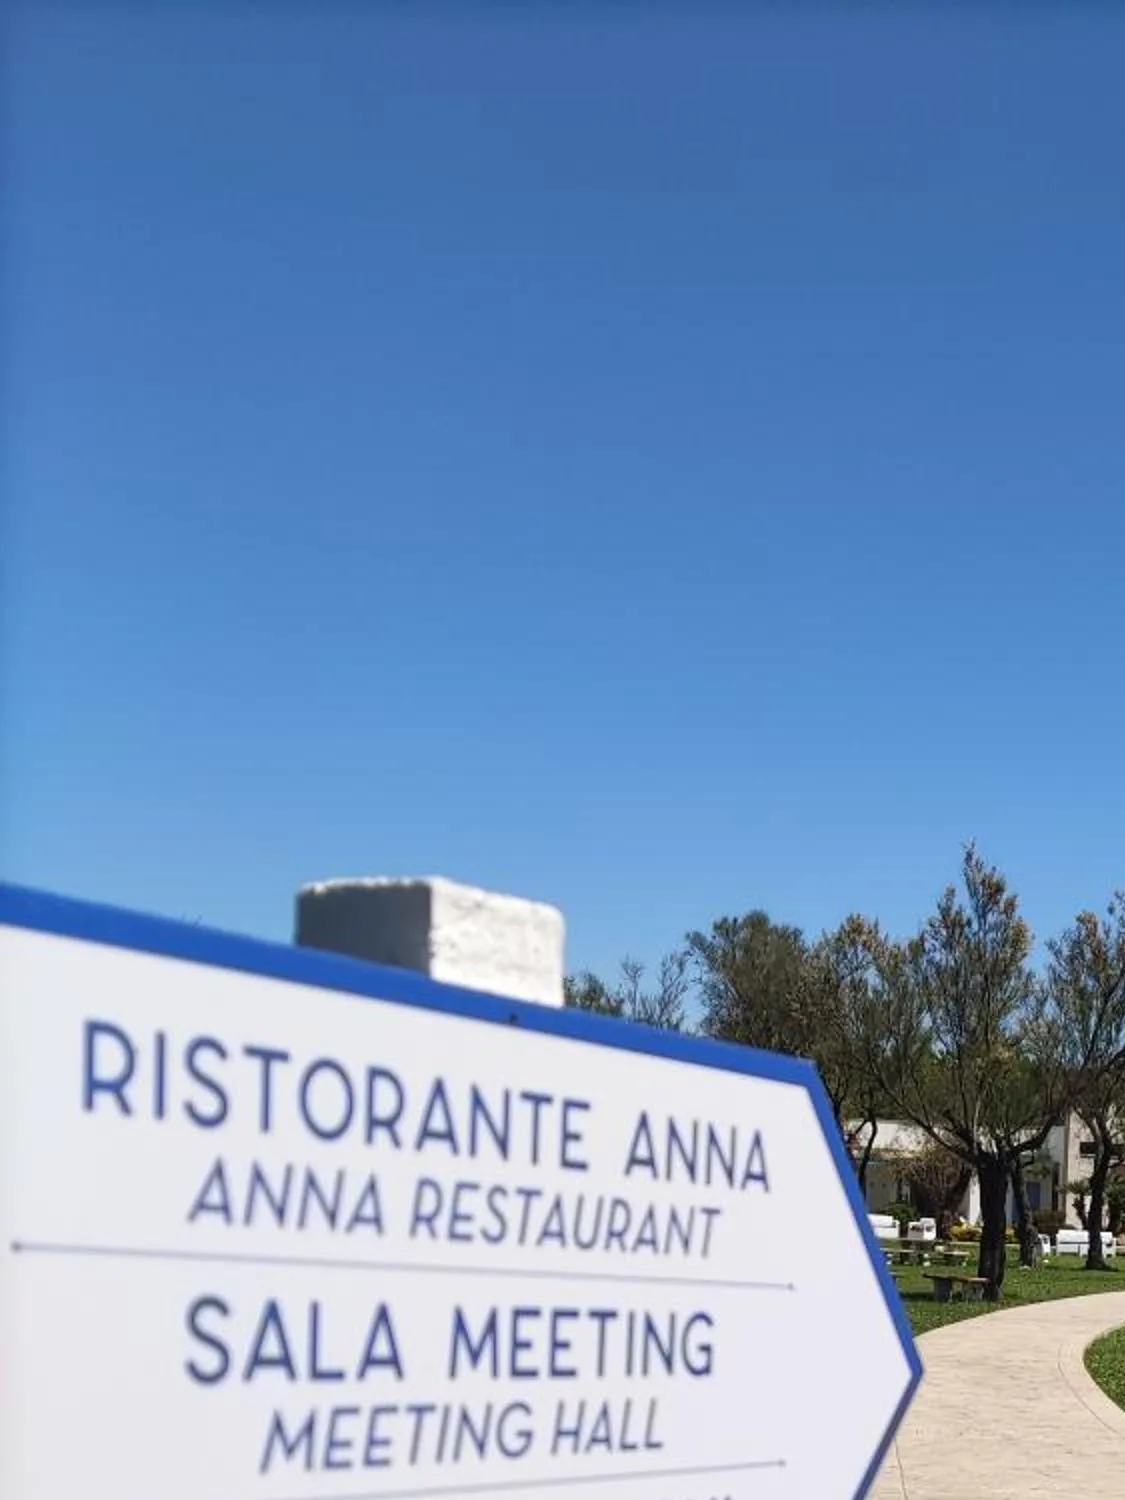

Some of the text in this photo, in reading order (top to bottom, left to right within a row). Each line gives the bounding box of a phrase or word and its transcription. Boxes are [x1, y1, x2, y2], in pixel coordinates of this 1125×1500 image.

[80, 1017, 771, 1195] RISTORANTE ANNA
[186, 1156, 723, 1257] ANNA RESTAURANT
[183, 1293, 716, 1389] SALA MEETING
[258, 1398, 665, 1475] MEETING HALL
